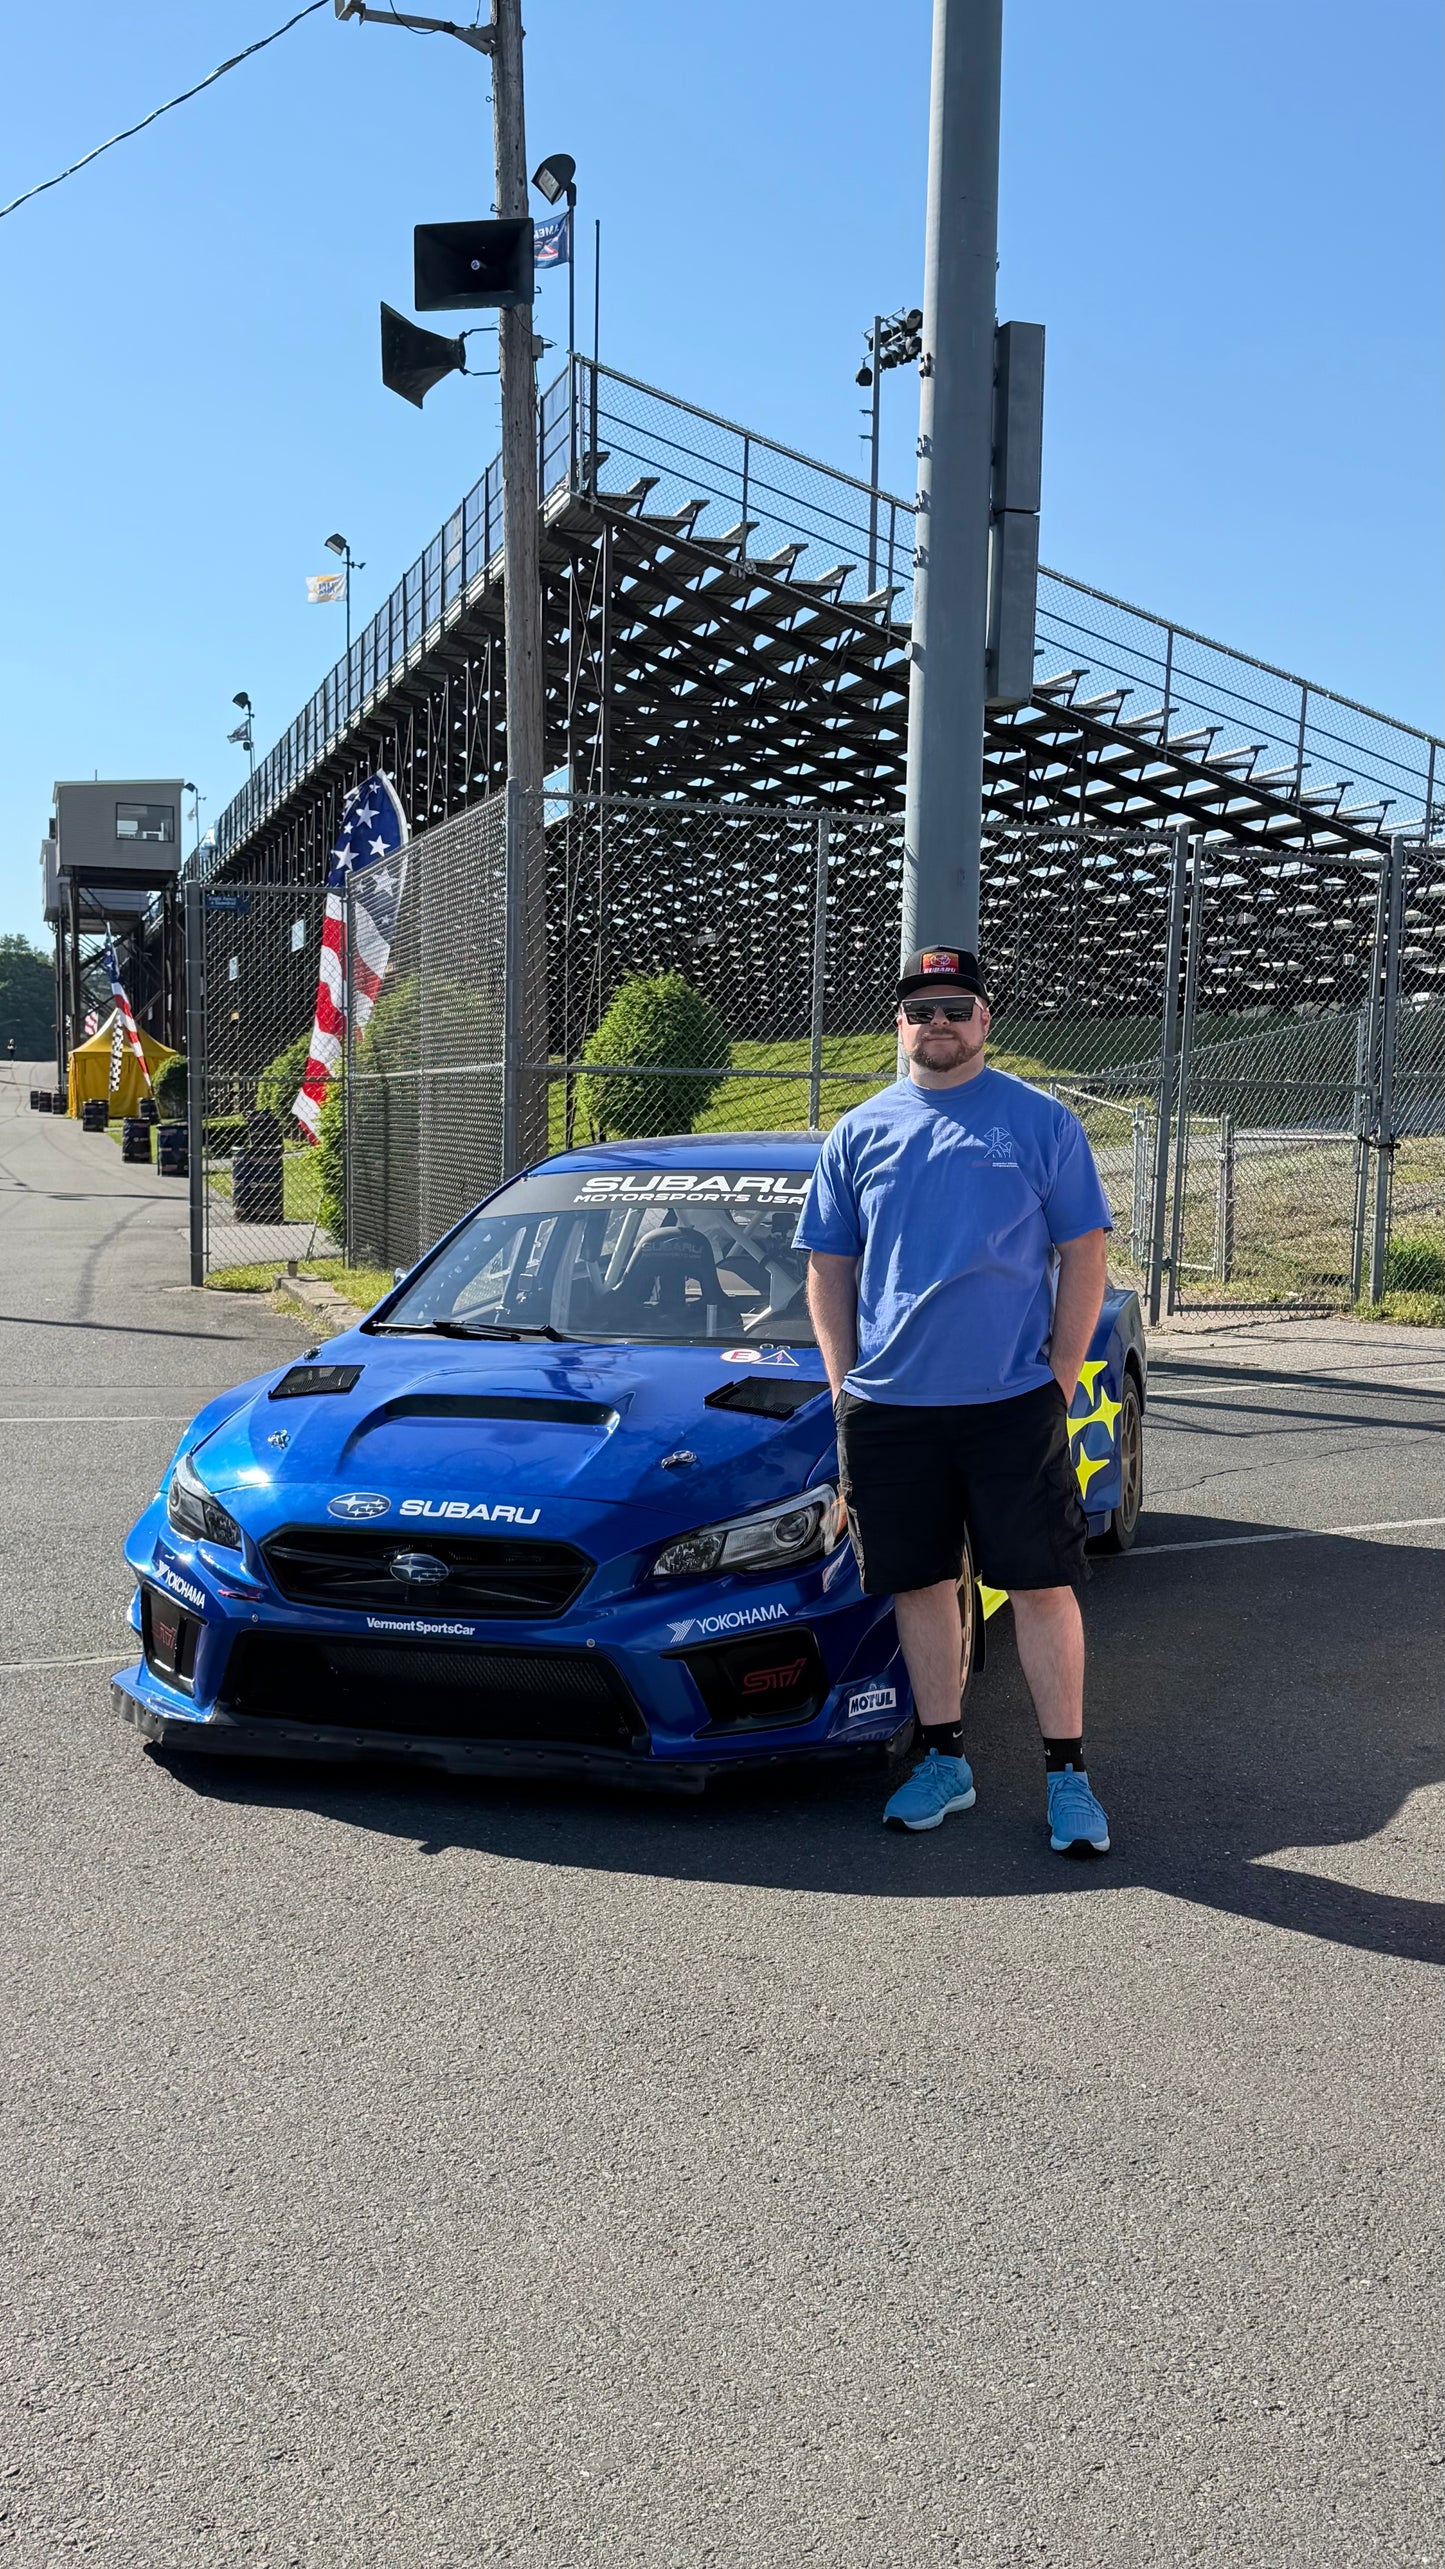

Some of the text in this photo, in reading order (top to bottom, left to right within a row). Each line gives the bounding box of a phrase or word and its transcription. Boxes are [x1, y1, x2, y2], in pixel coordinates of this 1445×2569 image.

[581, 1175, 812, 1194] SUBARU
[573, 1192, 805, 1205] MOTORSPORTS USA
[731, 1351, 752, 1361] E
[400, 1499, 541, 1524] SUBARU
[165, 1569, 206, 1609] YOKOHAMA
[696, 1603, 789, 1634] YOKOHAMA
[850, 1691, 894, 1714] MOTUL
